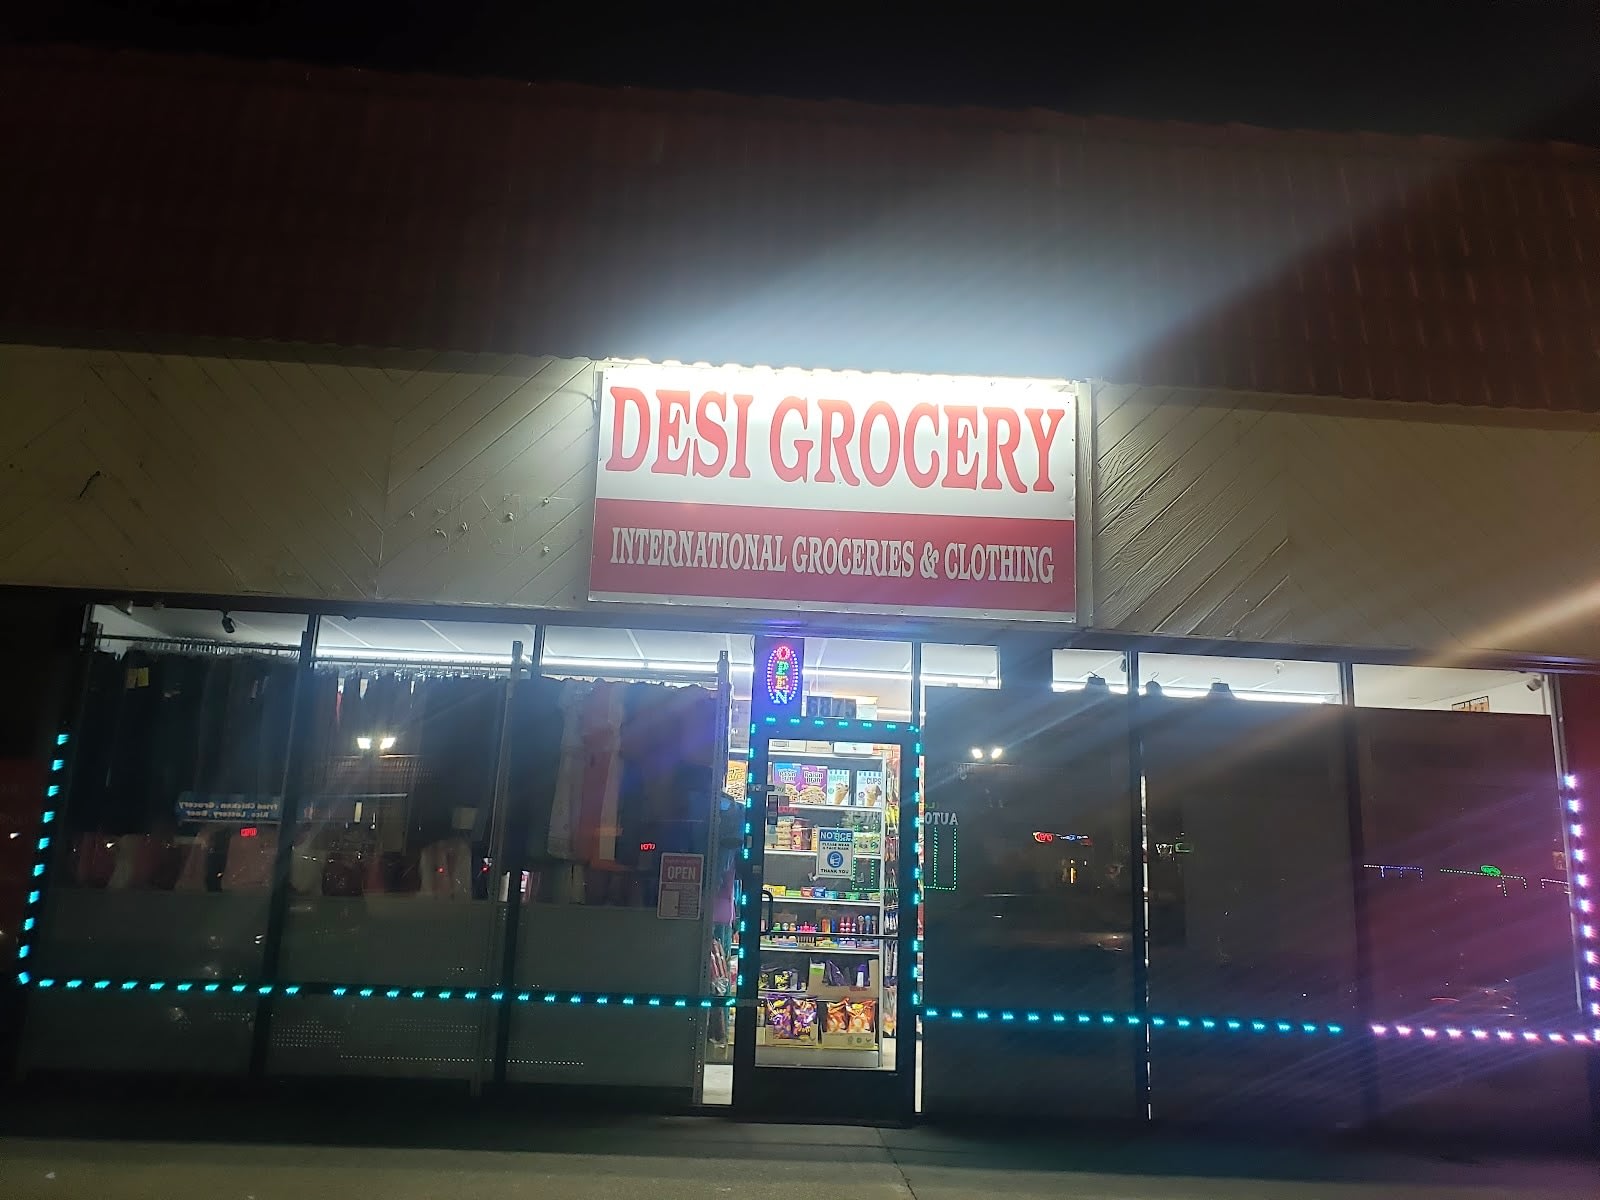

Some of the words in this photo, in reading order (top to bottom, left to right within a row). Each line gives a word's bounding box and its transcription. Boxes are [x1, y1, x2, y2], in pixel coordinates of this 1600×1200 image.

[605, 386, 754, 478] DESI
[769, 396, 1065, 493] GROCERY
[610, 527, 787, 572] INTERNATIONAL
[791, 536, 915, 578] GROCERIES
[919, 541, 940, 579] &
[944, 542, 1055, 584] CLOTHING
[774, 645, 791, 705] OPEN
[866, 777, 882, 785] CUPS
[820, 831, 852, 841] NOTICE
[667, 865, 696, 880] OPEN
